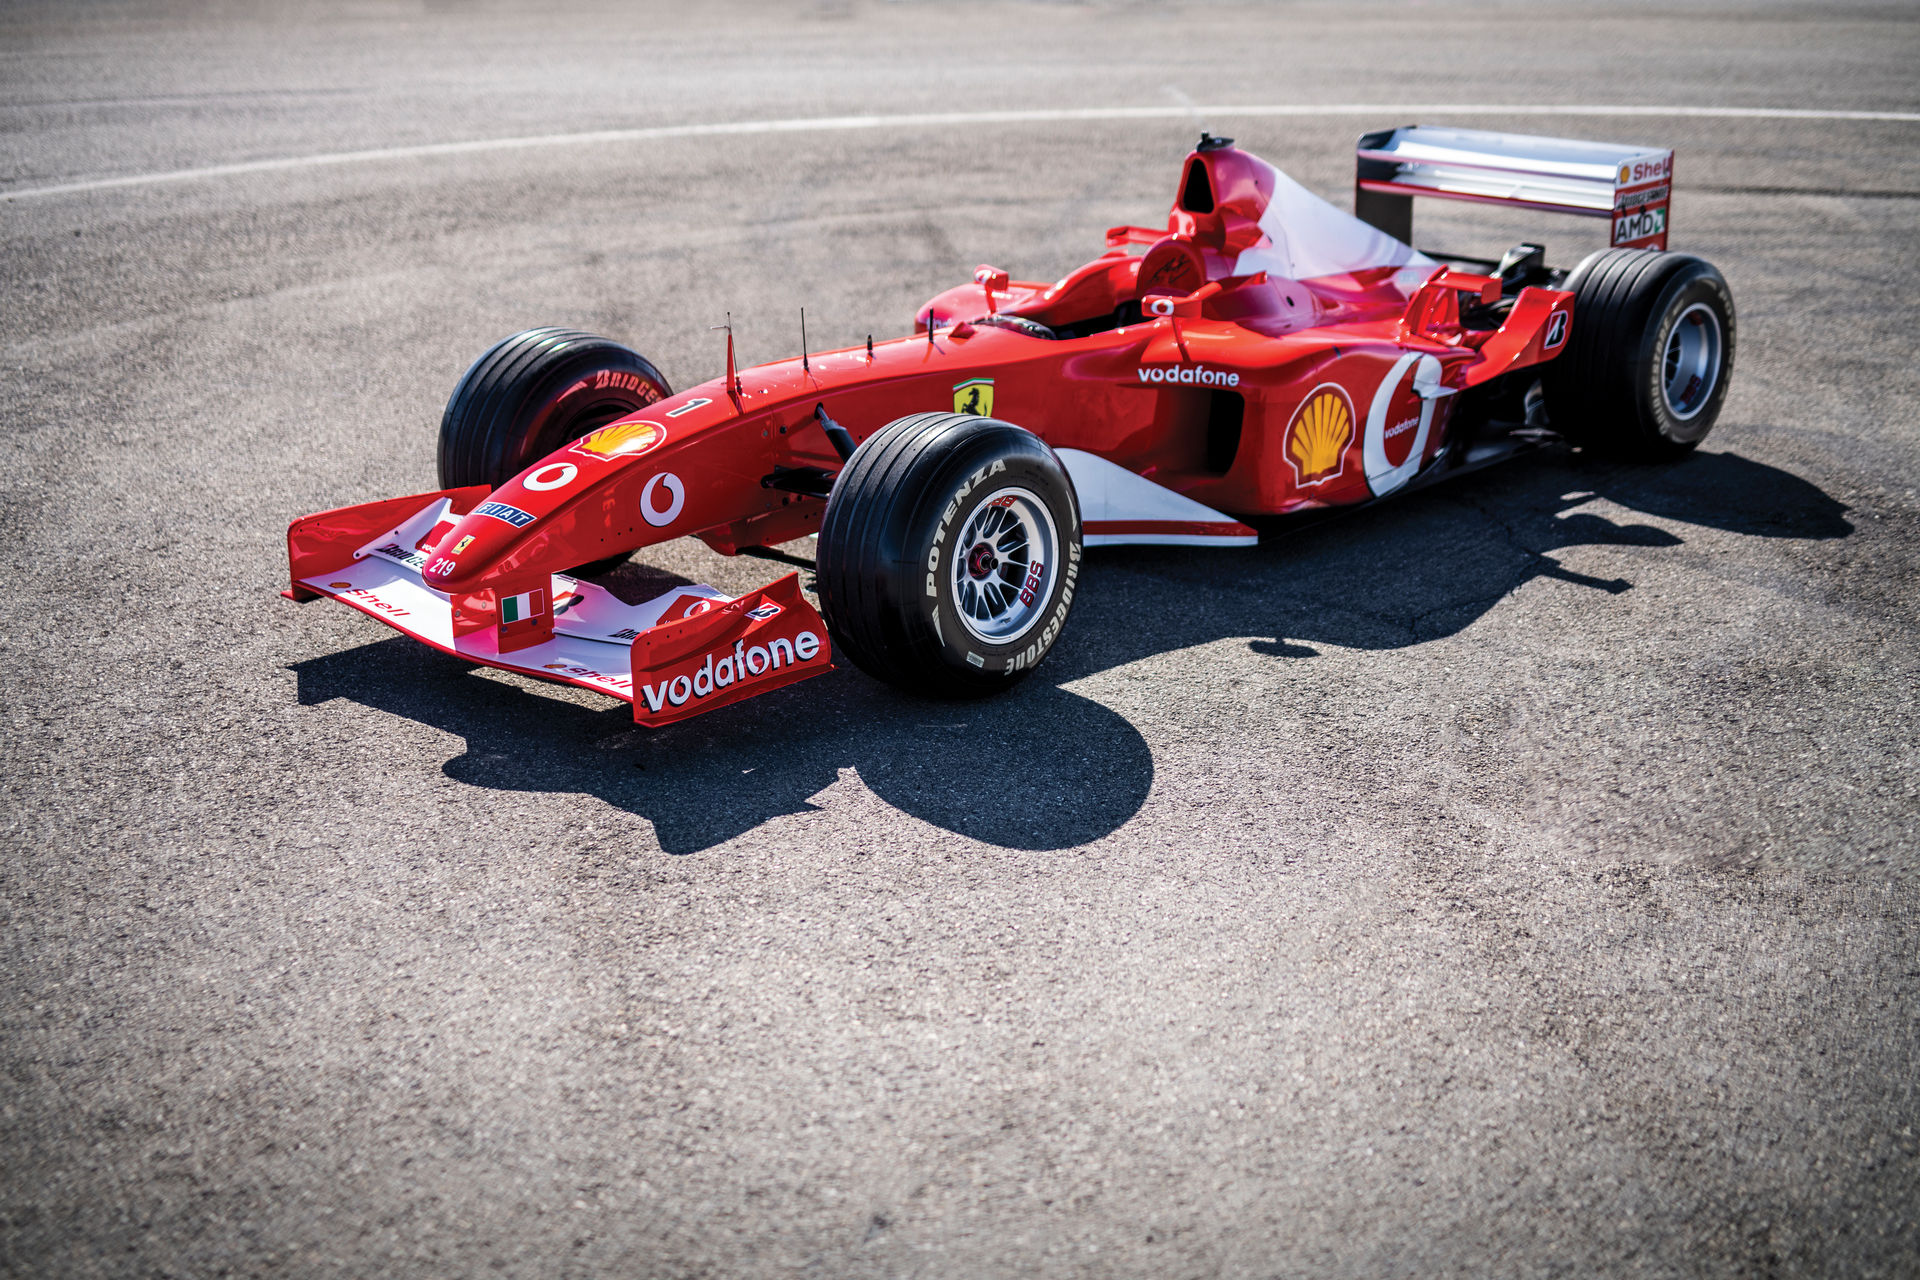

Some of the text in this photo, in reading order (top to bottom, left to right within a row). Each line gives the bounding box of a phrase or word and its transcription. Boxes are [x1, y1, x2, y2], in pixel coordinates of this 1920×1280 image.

[1615, 214, 1654, 242] AMD
[1137, 364, 1240, 387] vodafone
[665, 397, 713, 418] 1
[1385, 416, 1419, 440] vodafone
[477, 503, 531, 524] FIAT
[926, 459, 1007, 598] POTENZA
[429, 557, 456, 576] 219
[1019, 560, 1045, 608] BBS
[345, 588, 412, 617] Shell
[642, 631, 820, 712] vodafone
